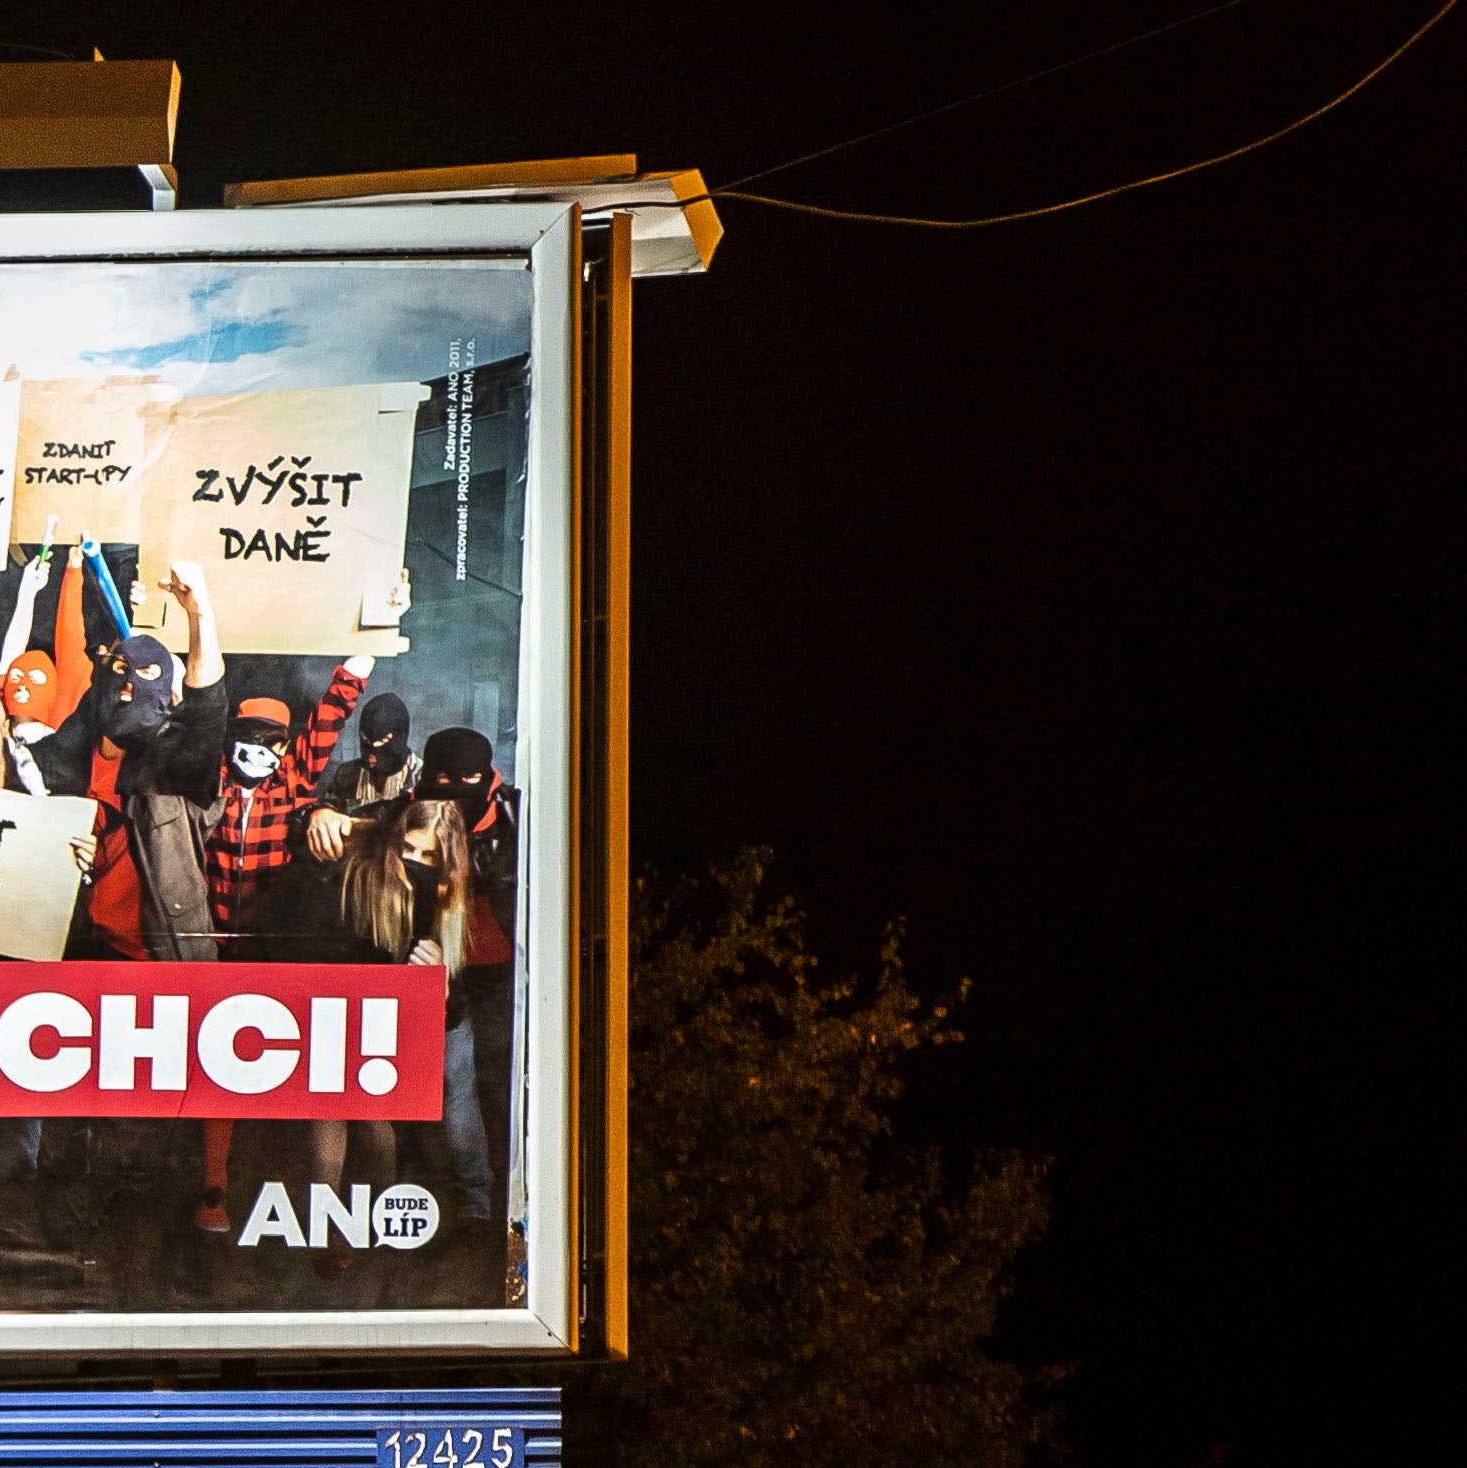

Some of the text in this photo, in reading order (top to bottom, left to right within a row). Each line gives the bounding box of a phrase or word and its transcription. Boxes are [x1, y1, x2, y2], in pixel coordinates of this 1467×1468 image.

[443, 337, 462, 471] Zadavatel: ANO 2011,
[42, 439, 117, 459] ZDANIT
[455, 337, 477, 581] zpracovatel: PRODUCTION TEAM, s.r.o.
[191, 454, 364, 508] ZVÝŠIT
[219, 515, 332, 564] DANĚ
[383, 1197, 429, 1211] BUDE
[383, 1212, 428, 1238] LÍP
